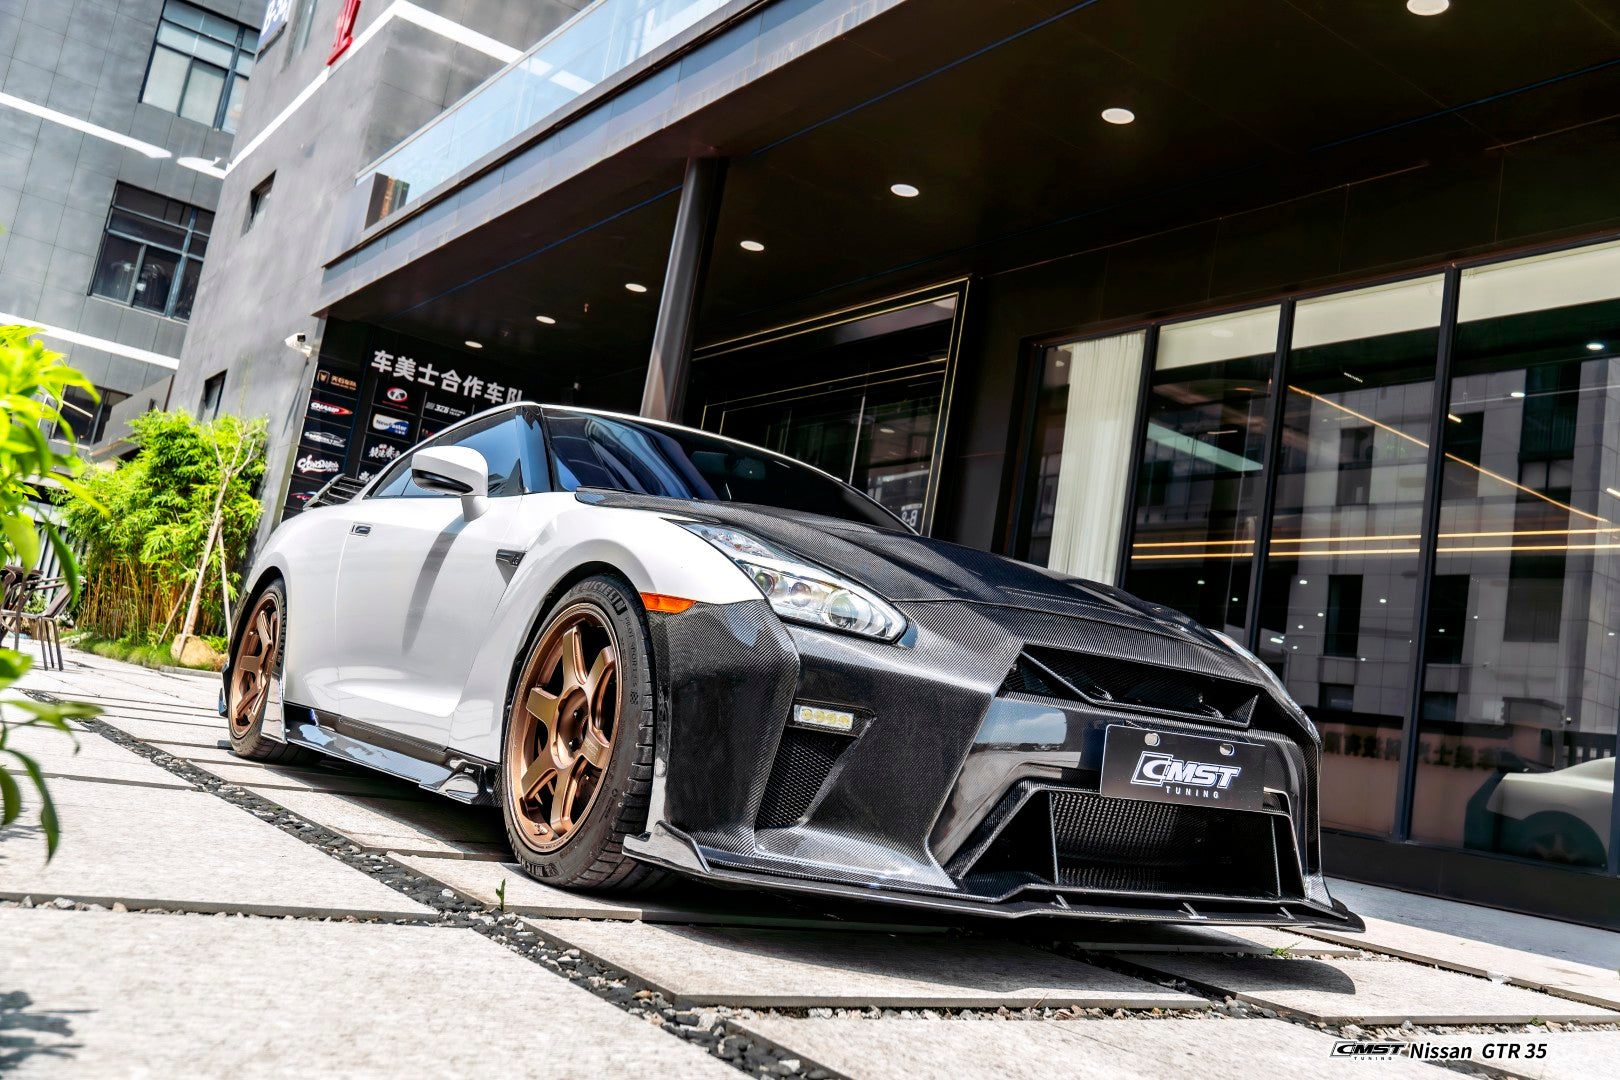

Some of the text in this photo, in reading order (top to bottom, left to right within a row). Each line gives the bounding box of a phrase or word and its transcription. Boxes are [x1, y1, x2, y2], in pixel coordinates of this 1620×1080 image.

[371, 350, 524, 403] 车美士合作车队
[310, 401, 340, 413] CHAMP
[583, 580, 629, 615] MICHELIN
[1130, 751, 1242, 789] CMST
[1165, 786, 1220, 799] TUNING
